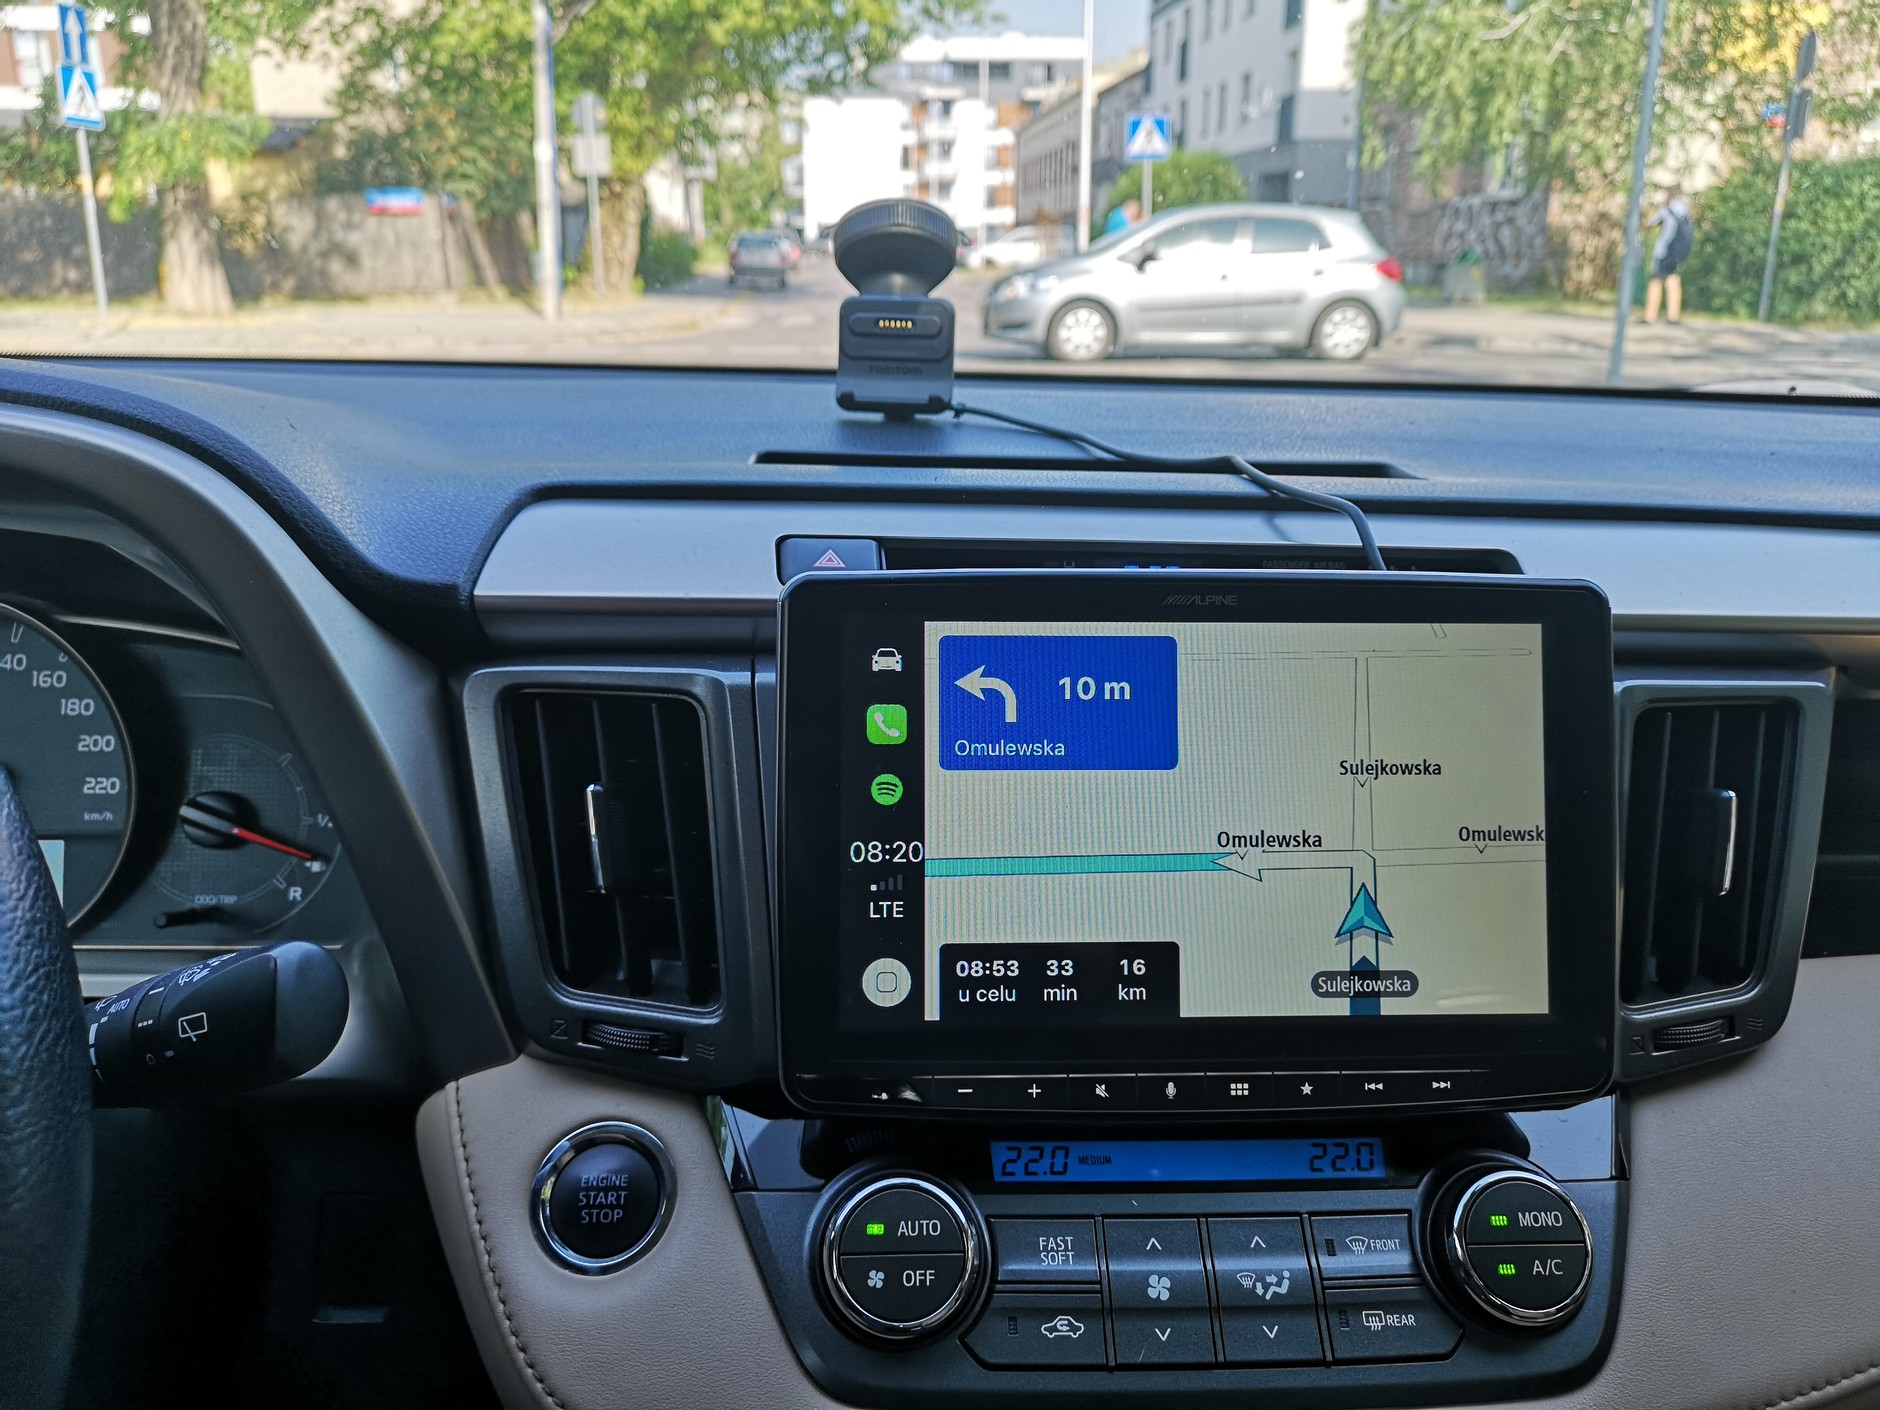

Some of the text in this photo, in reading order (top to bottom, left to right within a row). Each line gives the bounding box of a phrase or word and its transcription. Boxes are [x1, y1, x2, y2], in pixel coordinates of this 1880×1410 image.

[1186, 594, 1239, 606] ALPINE
[32, 670, 67, 688] 160
[1058, 676, 1132, 701] 10 m
[60, 698, 95, 716] 180
[78, 734, 115, 752] 200
[954, 739, 1066, 756] Omulewska
[1339, 758, 1442, 781] Sulejkowska
[83, 777, 120, 794] 220
[83, 811, 114, 821] km/h
[1217, 830, 1323, 848] Omulewska
[850, 841, 924, 863] 08:20
[287, 886, 303, 901] R
[869, 901, 905, 918] LTE
[956, 958, 1146, 977] 08:53 33 16
[958, 983, 1147, 1002] u celu min km
[1318, 976, 1411, 996] Sulejkowska
[1001, 1145, 1112, 1176] 22.0 MEDIUM
[1309, 1142, 1375, 1173] 22.0
[581, 1174, 629, 1188] ENGINE
[578, 1191, 628, 1206] START
[581, 1209, 623, 1224] STOP
[1518, 1211, 1563, 1227] MONO
[897, 1219, 941, 1237] AUTO
[1039, 1236, 1074, 1250] FAST
[1370, 1238, 1401, 1252] FRONT
[1040, 1252, 1075, 1266] SOFT
[1532, 1259, 1564, 1275] A/C
[902, 1270, 936, 1287] OFF
[1386, 1313, 1417, 1327] REAR
